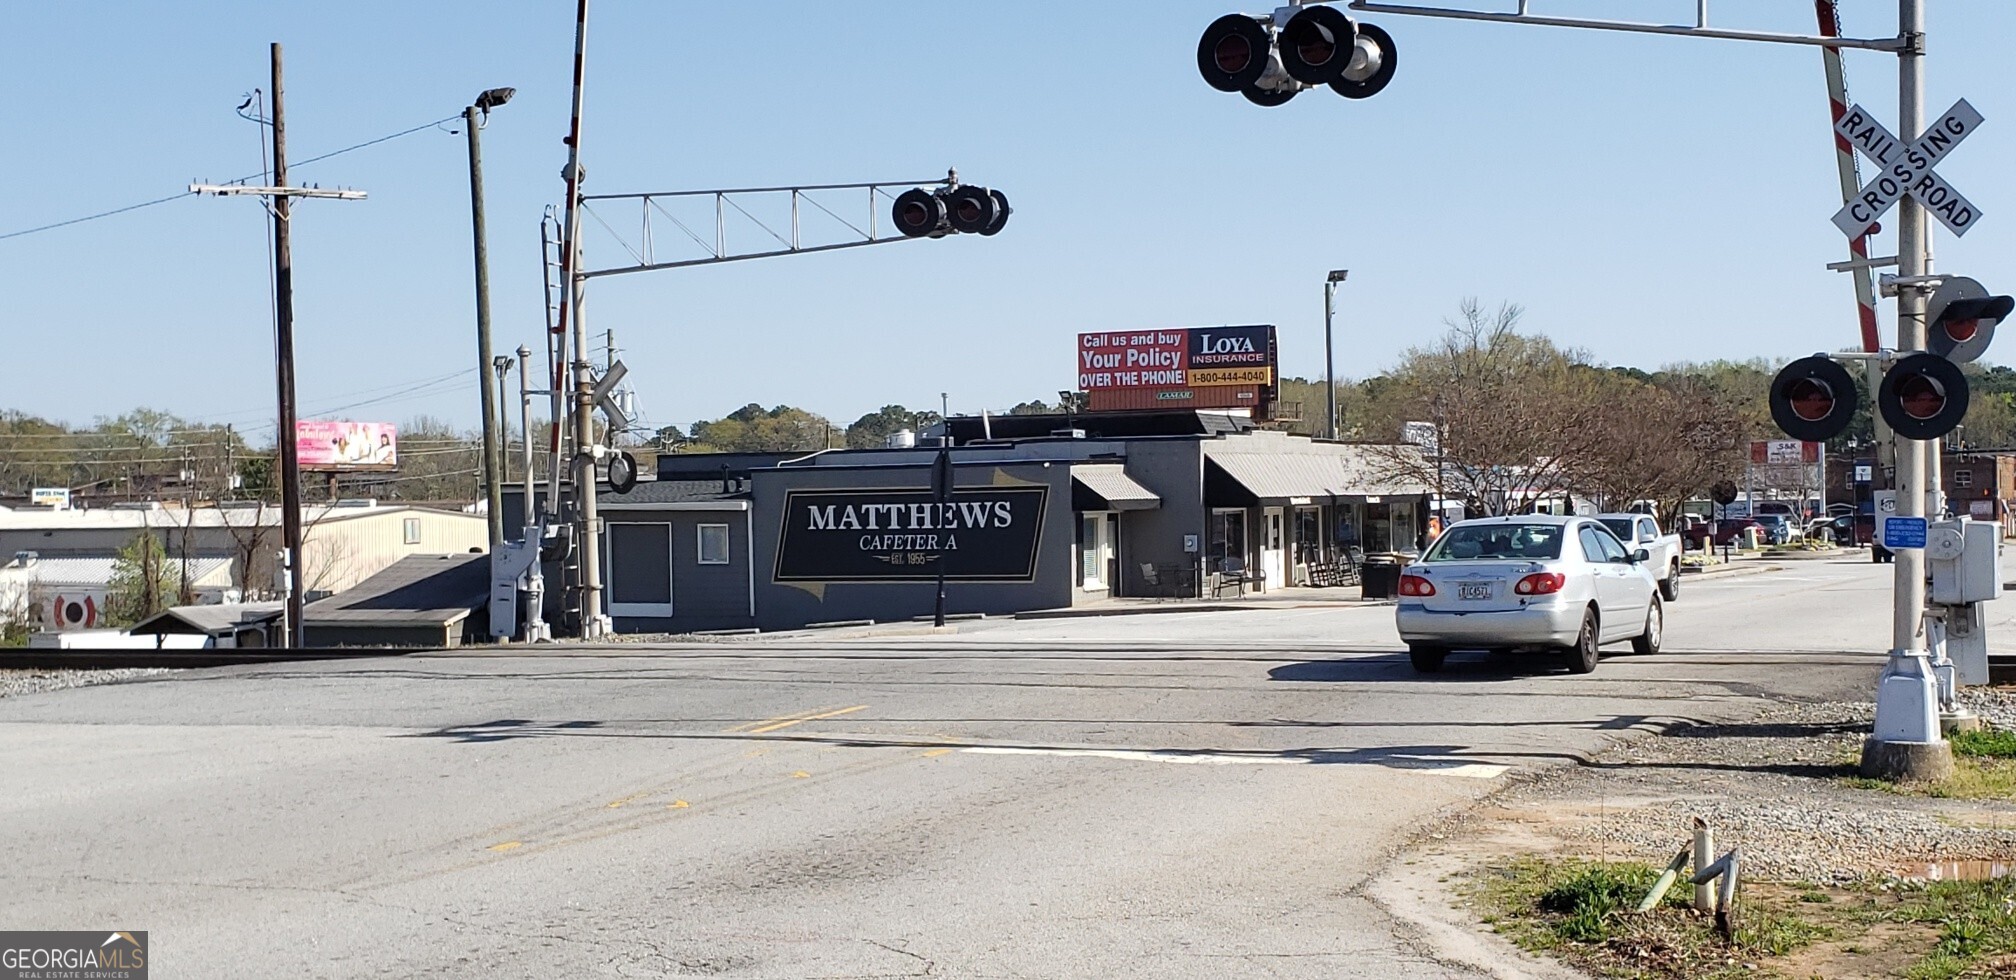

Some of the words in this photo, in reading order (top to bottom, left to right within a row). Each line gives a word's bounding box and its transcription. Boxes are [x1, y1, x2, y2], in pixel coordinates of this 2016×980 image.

[1841, 111, 1893, 165] RAIL
[1850, 116, 1965, 223] CROSSING
[1913, 174, 1972, 228] ROAD
[1083, 334, 1108, 347] Call
[1112, 335, 1127, 346] us
[1130, 332, 1154, 345] and
[1158, 332, 1181, 346] buy
[1201, 334, 1255, 353] LOYA
[1082, 350, 1121, 369] Your
[1126, 347, 1181, 369] Policy
[1192, 353, 1264, 364] INSURANCE
[1080, 372, 1112, 387] OVER
[1114, 371, 1138, 386] THE
[1141, 369, 1186, 385] PHONE!
[1192, 371, 1265, 383] 1-800-444-4040
[807, 501, 1013, 530] MATTHEWS
[859, 534, 958, 550] CAFETERA
[907, 552, 926, 565] 1955
